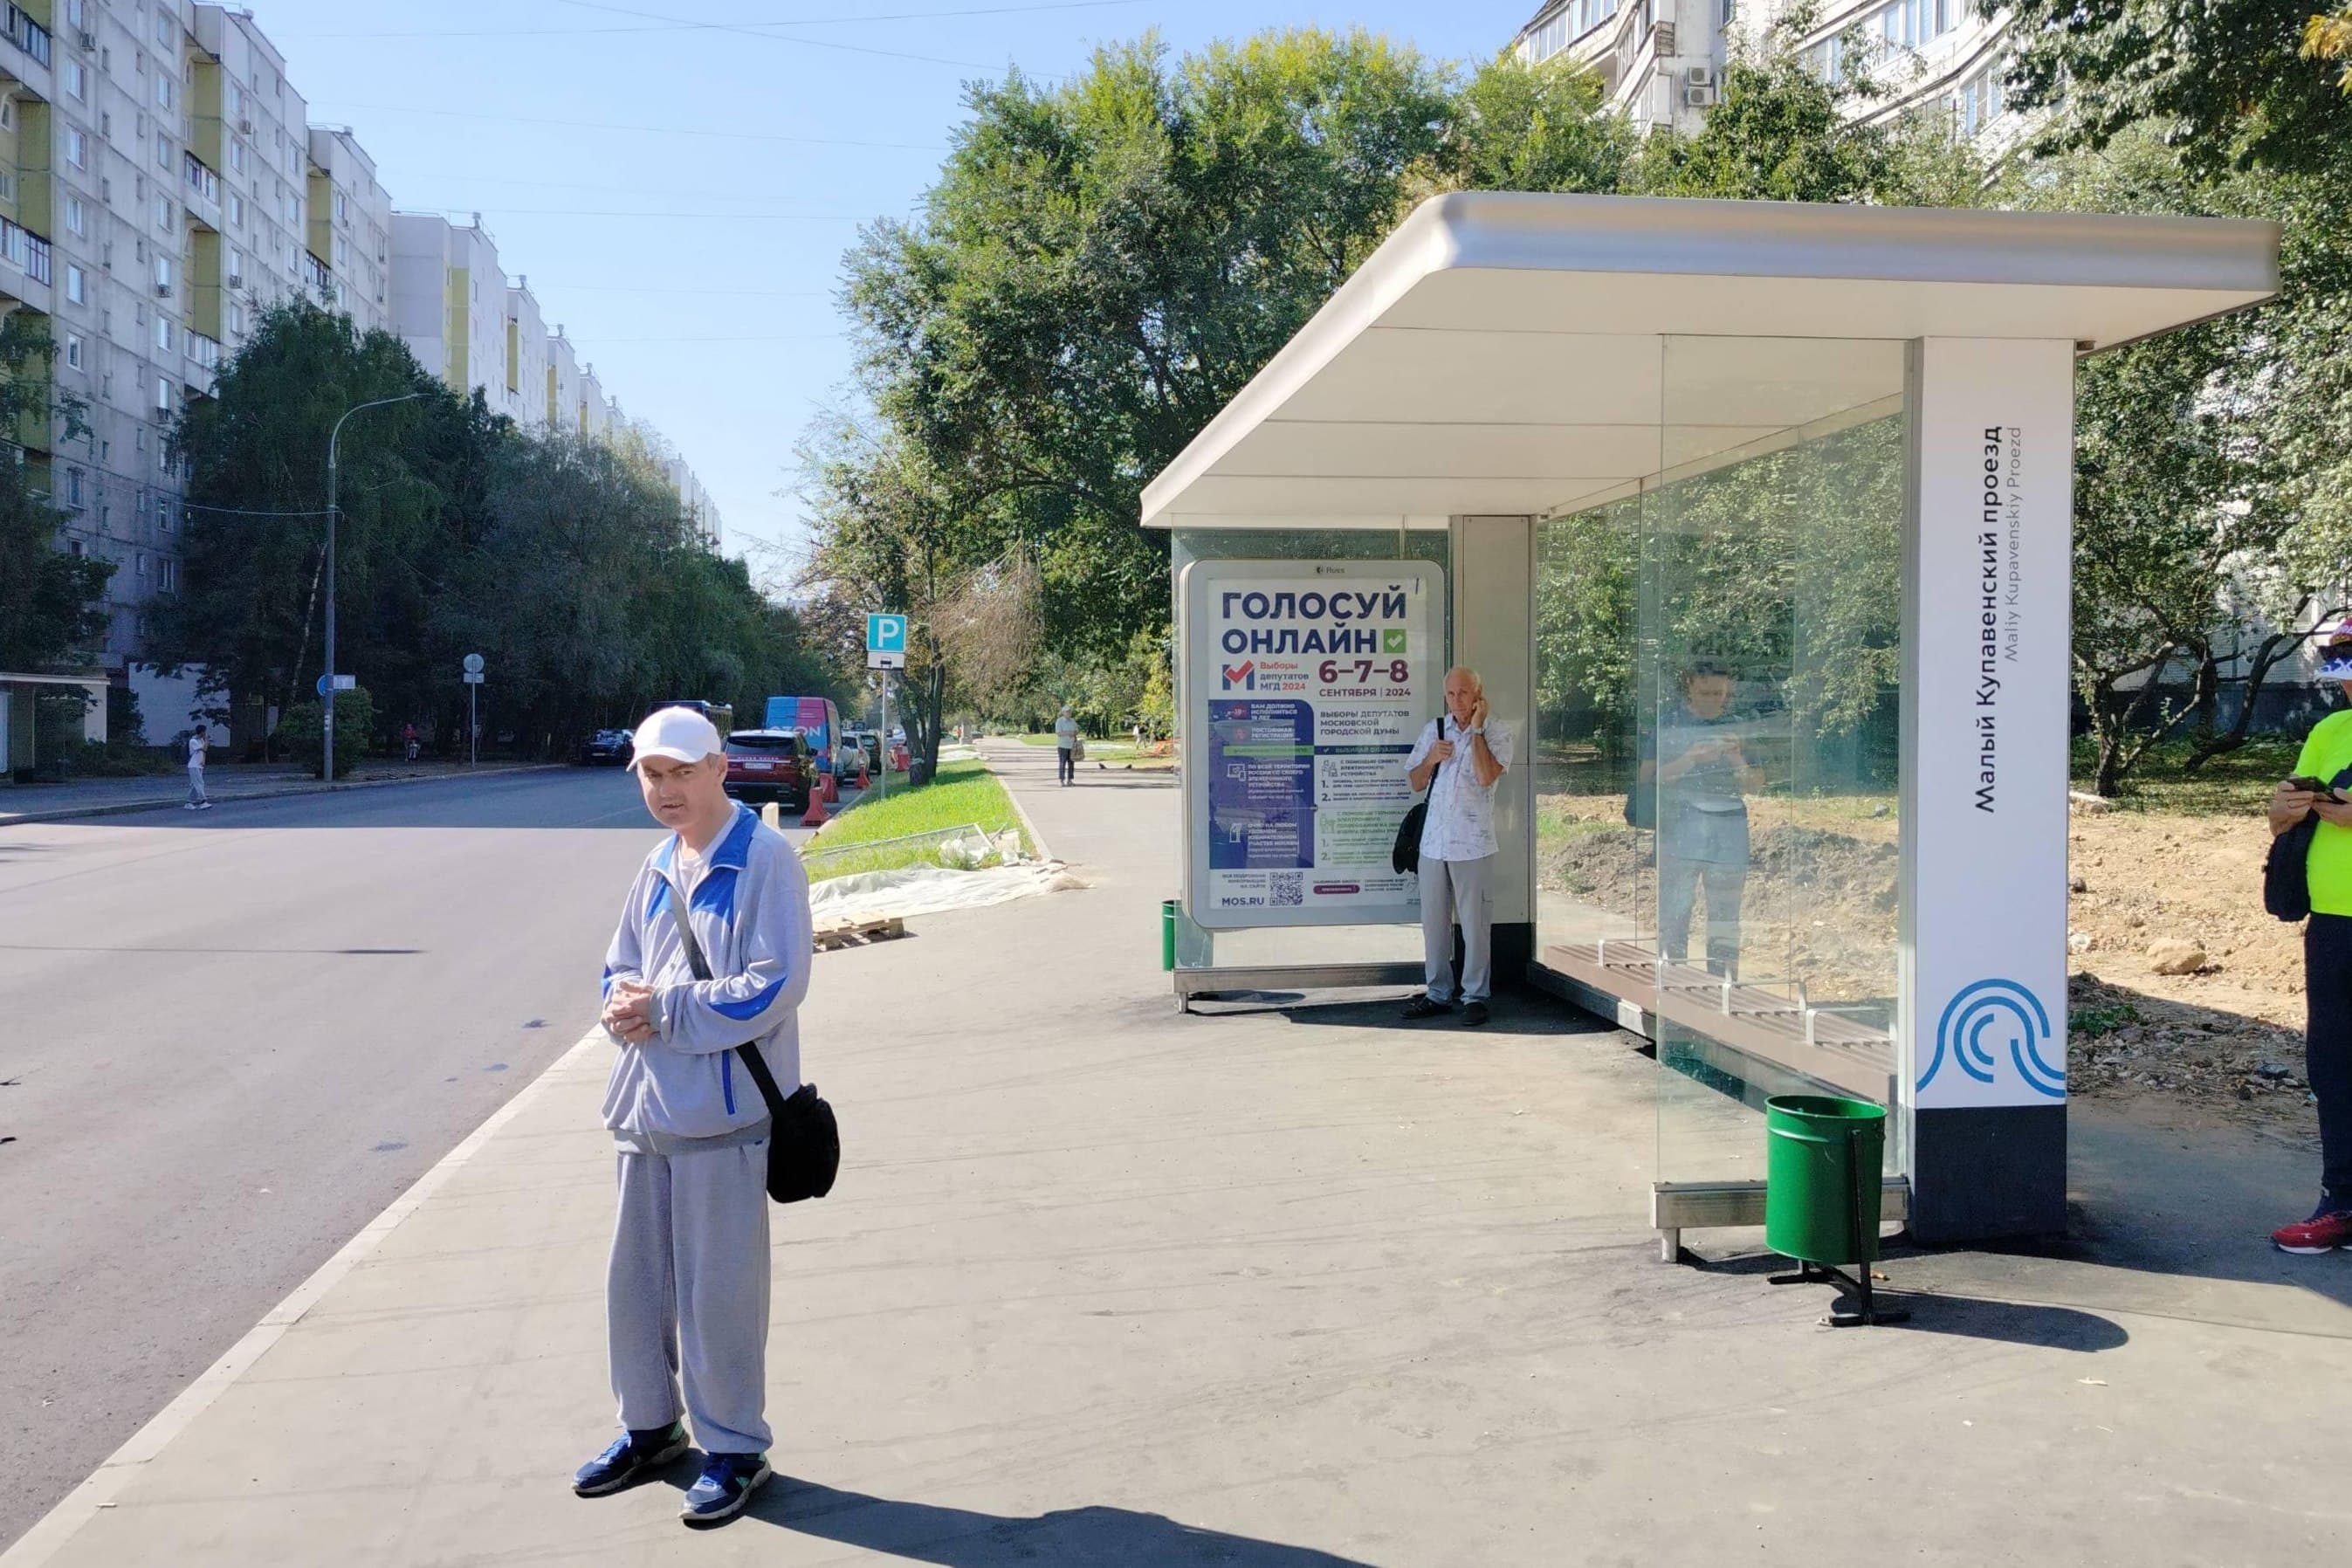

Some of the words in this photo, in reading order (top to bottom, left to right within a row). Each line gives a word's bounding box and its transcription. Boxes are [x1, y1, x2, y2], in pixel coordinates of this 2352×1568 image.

[1983, 425, 2003, 523] проезд
[2006, 426, 2021, 488] Proezd
[2005, 494, 2022, 606] Kupavenskiy
[1222, 585, 1406, 619] ГОЛОСУЙ
[1976, 531, 2001, 705] Купавенский
[877, 618, 899, 648] P
[1221, 622, 1377, 654] ОНЛАЙН
[2005, 616, 2022, 662] Maliy
[1260, 662, 1298, 671] Выборы
[1319, 688, 1377, 697] СЕНТЯБРЯ
[1386, 688, 1411, 697] 2024
[1975, 715, 1995, 814] Малый
[1221, 897, 1265, 906] MOS.RU
